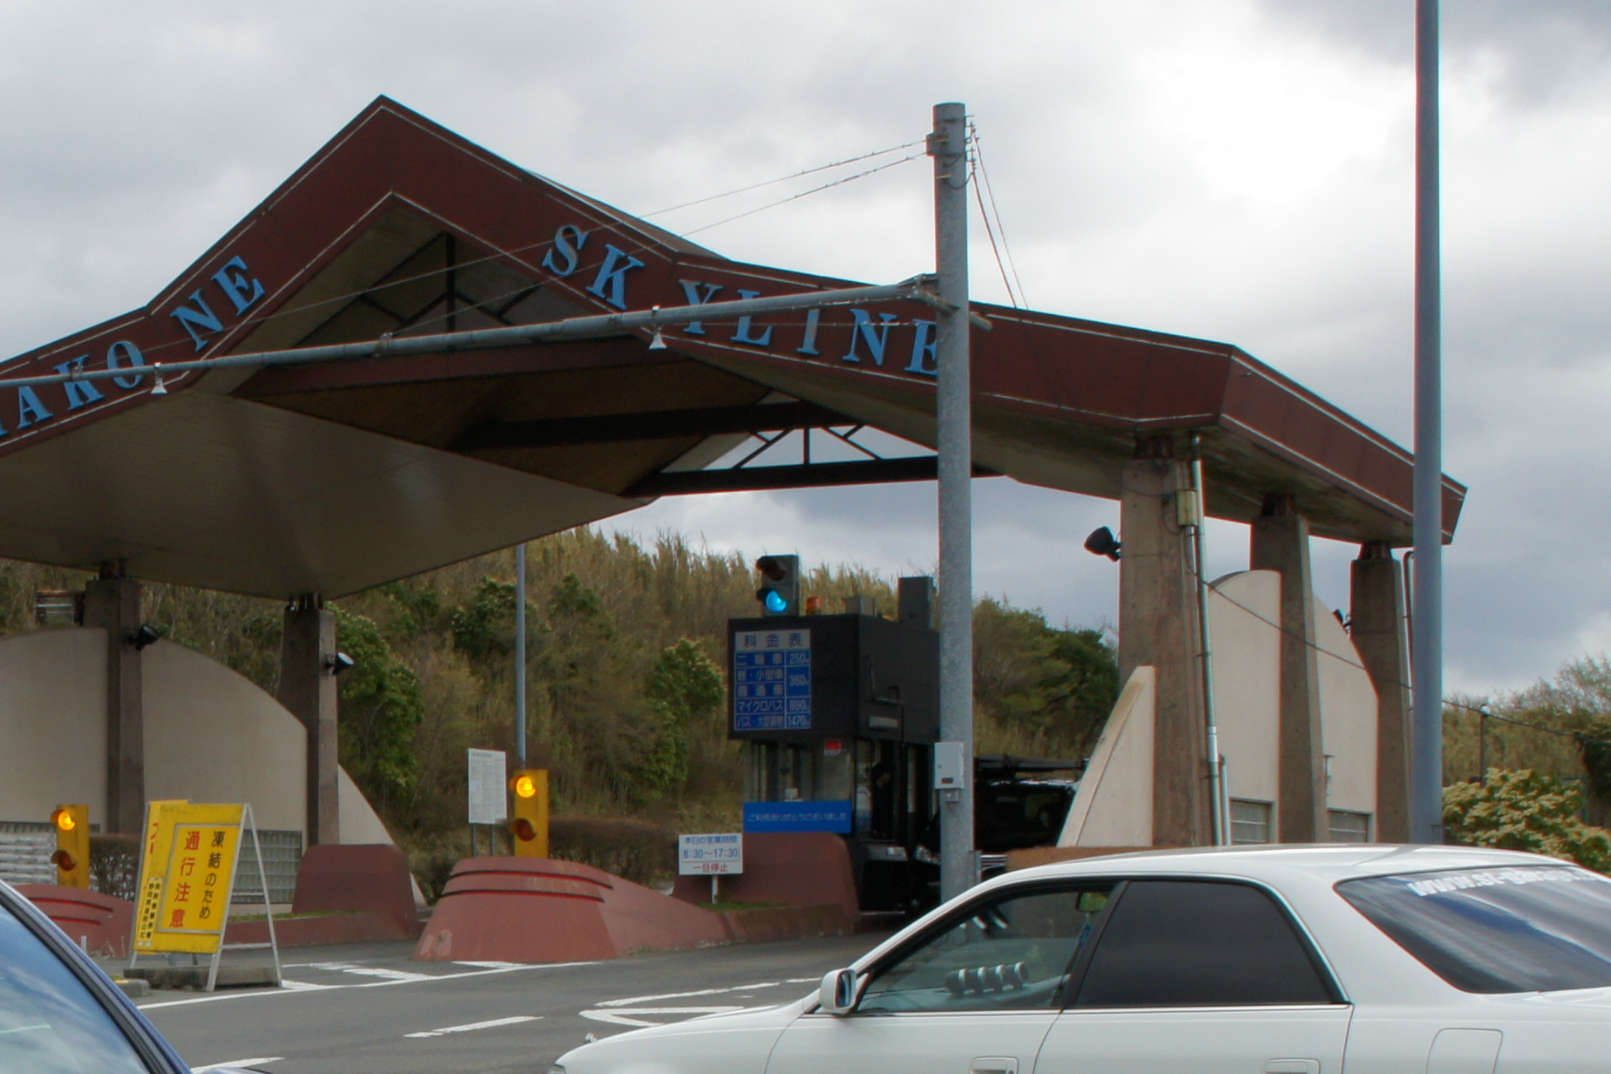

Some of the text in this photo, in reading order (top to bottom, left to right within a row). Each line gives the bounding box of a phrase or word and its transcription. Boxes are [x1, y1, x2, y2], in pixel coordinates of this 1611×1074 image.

[744, 632, 802, 649] 料金表
[737, 699, 784, 713] マイクロバス
[684, 835, 738, 845] 本日の営業時間
[199, 830, 226, 920] 凍結のため
[692, 862, 729, 873] 一旦停止
[169, 830, 201, 929] 通行注意
